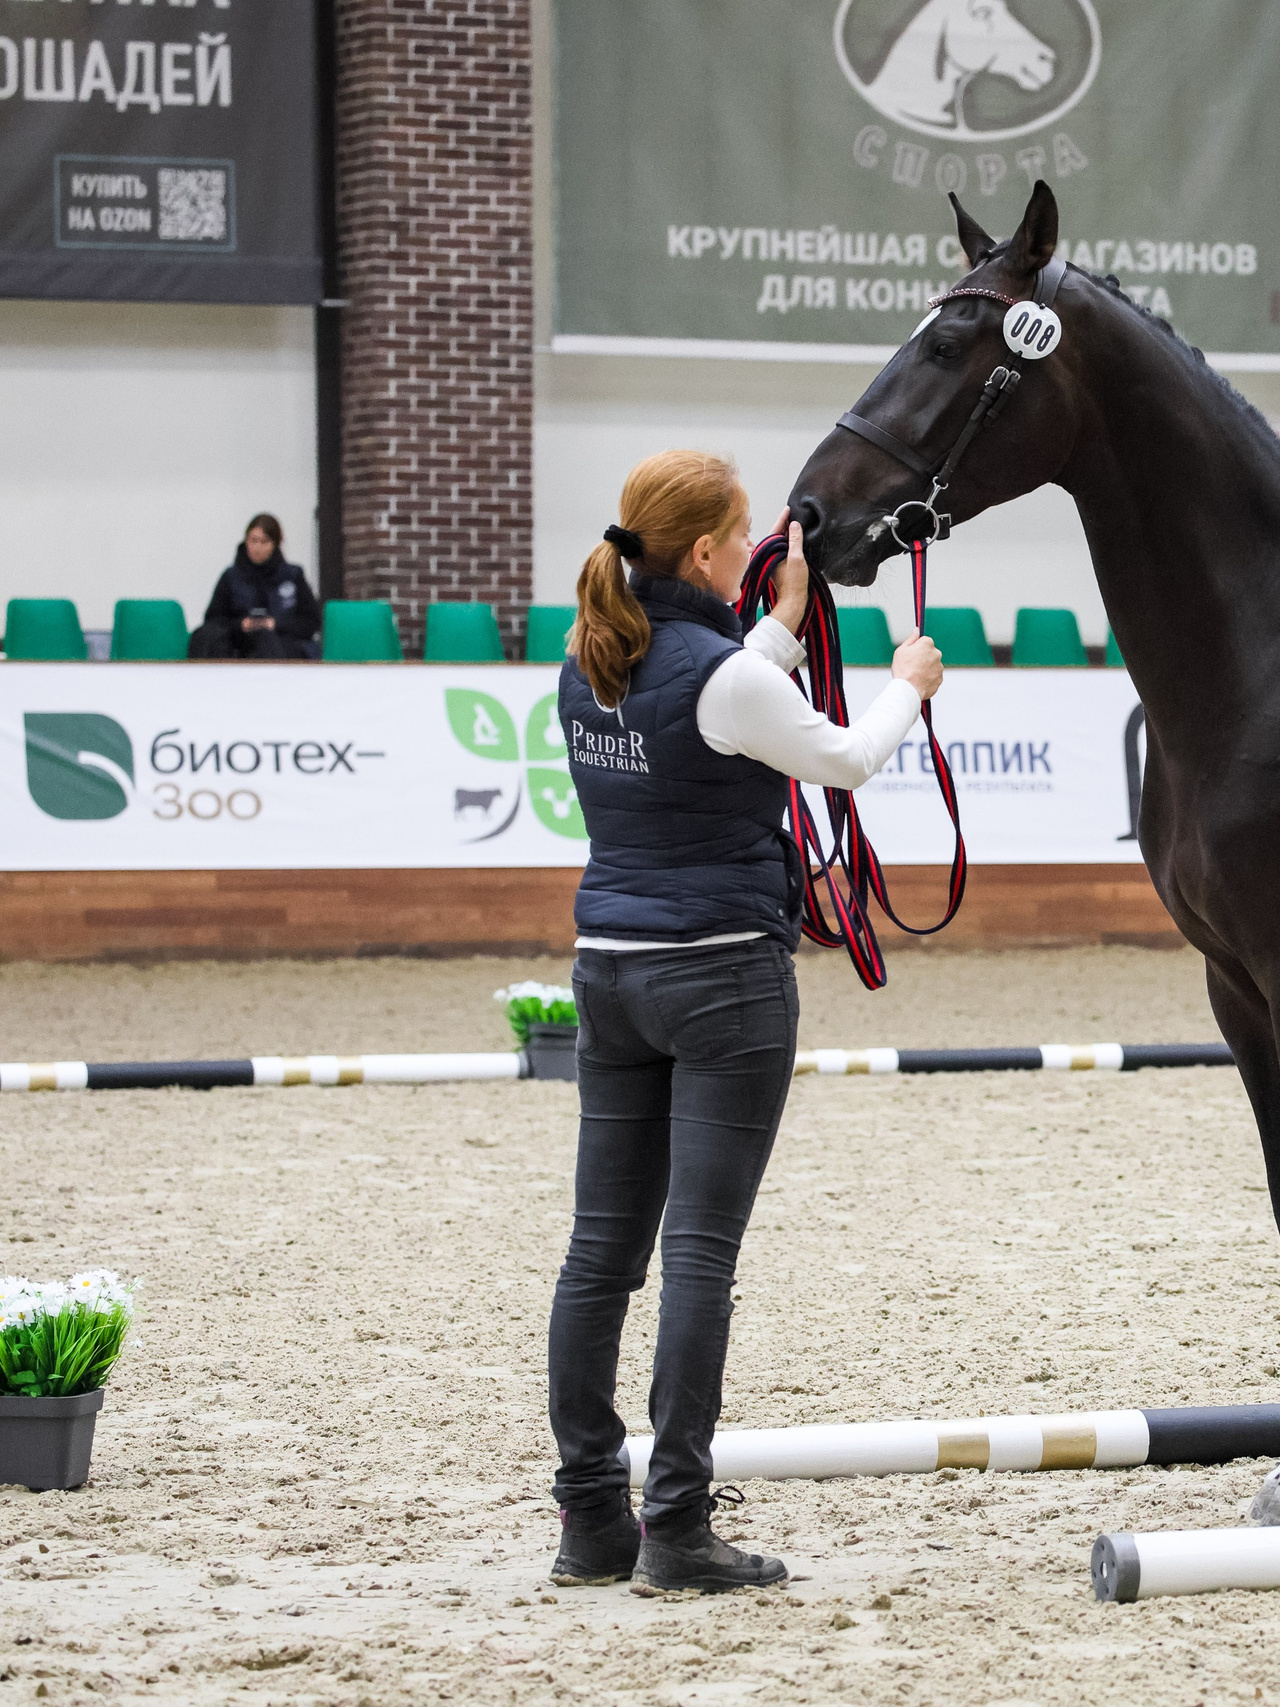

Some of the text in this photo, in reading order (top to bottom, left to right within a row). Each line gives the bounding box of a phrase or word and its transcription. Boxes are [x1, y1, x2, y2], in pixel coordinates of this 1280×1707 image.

[852, 124, 1090, 196] СПОРТА
[71, 173, 148, 199] КУПИТЬ
[67, 206, 152, 232] НА OZON
[667, 224, 929, 268] КРУПНЕЙШАЯ
[756, 273, 953, 314] ДЛЯ КОНН
[1011, 312, 1055, 352] 008
[573, 748, 650, 774] EQUESTRIAN
